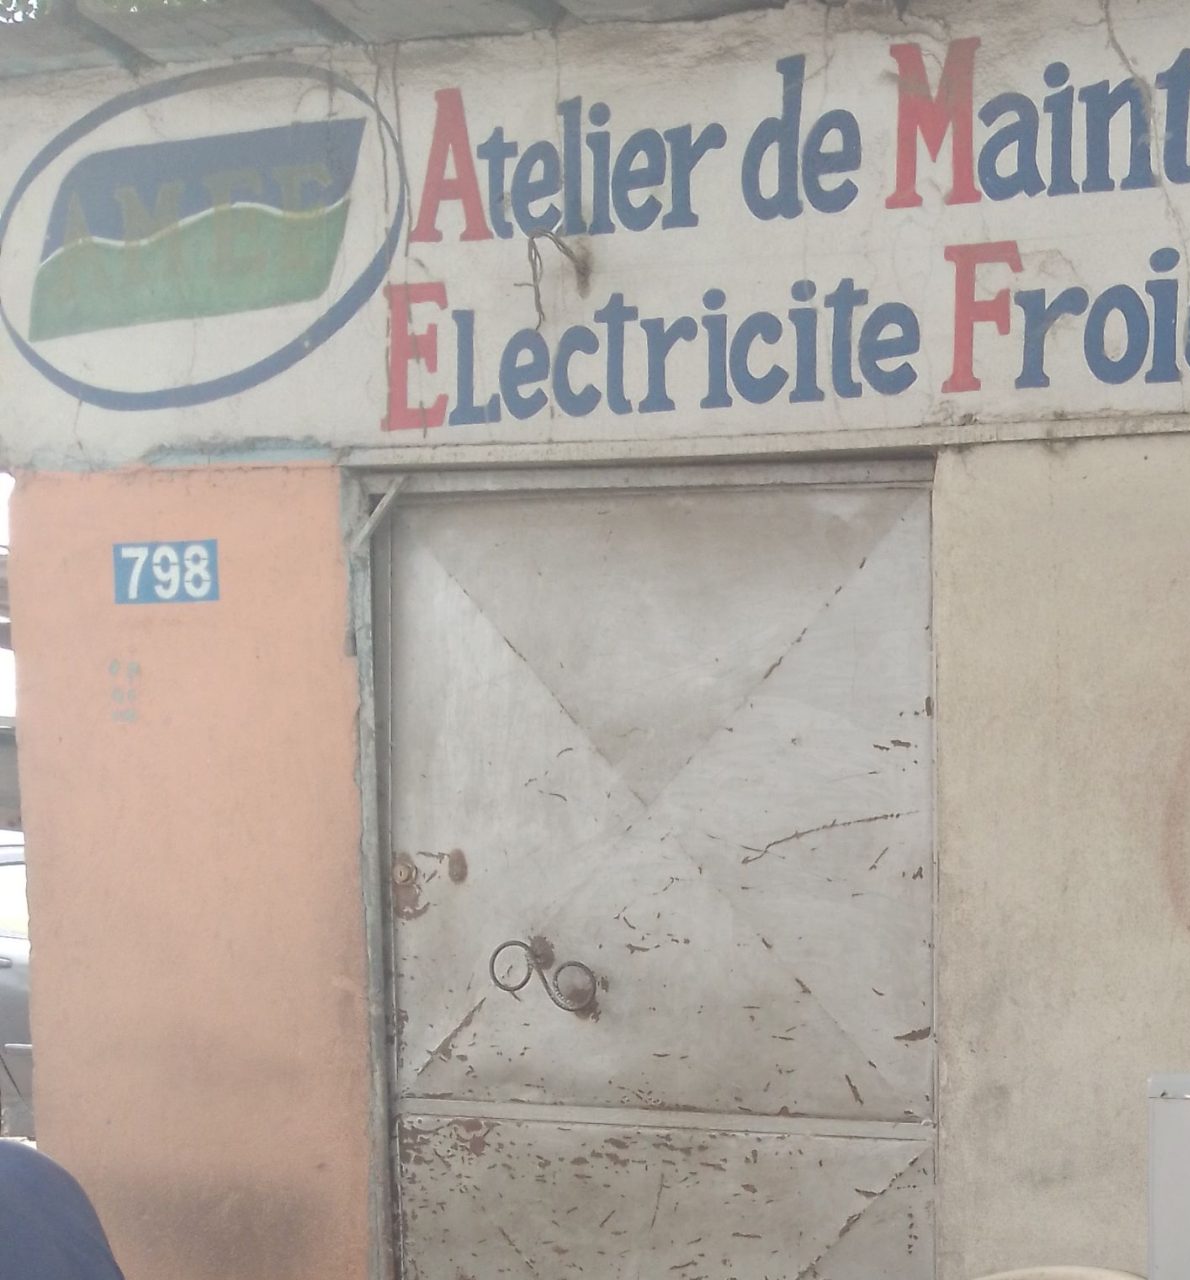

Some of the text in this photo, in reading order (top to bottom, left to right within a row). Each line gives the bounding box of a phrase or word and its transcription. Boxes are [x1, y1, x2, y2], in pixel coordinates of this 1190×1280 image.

[410, 88, 727, 243] Atelier
[741, 53, 862, 228] de
[121, 545, 212, 599] 798
